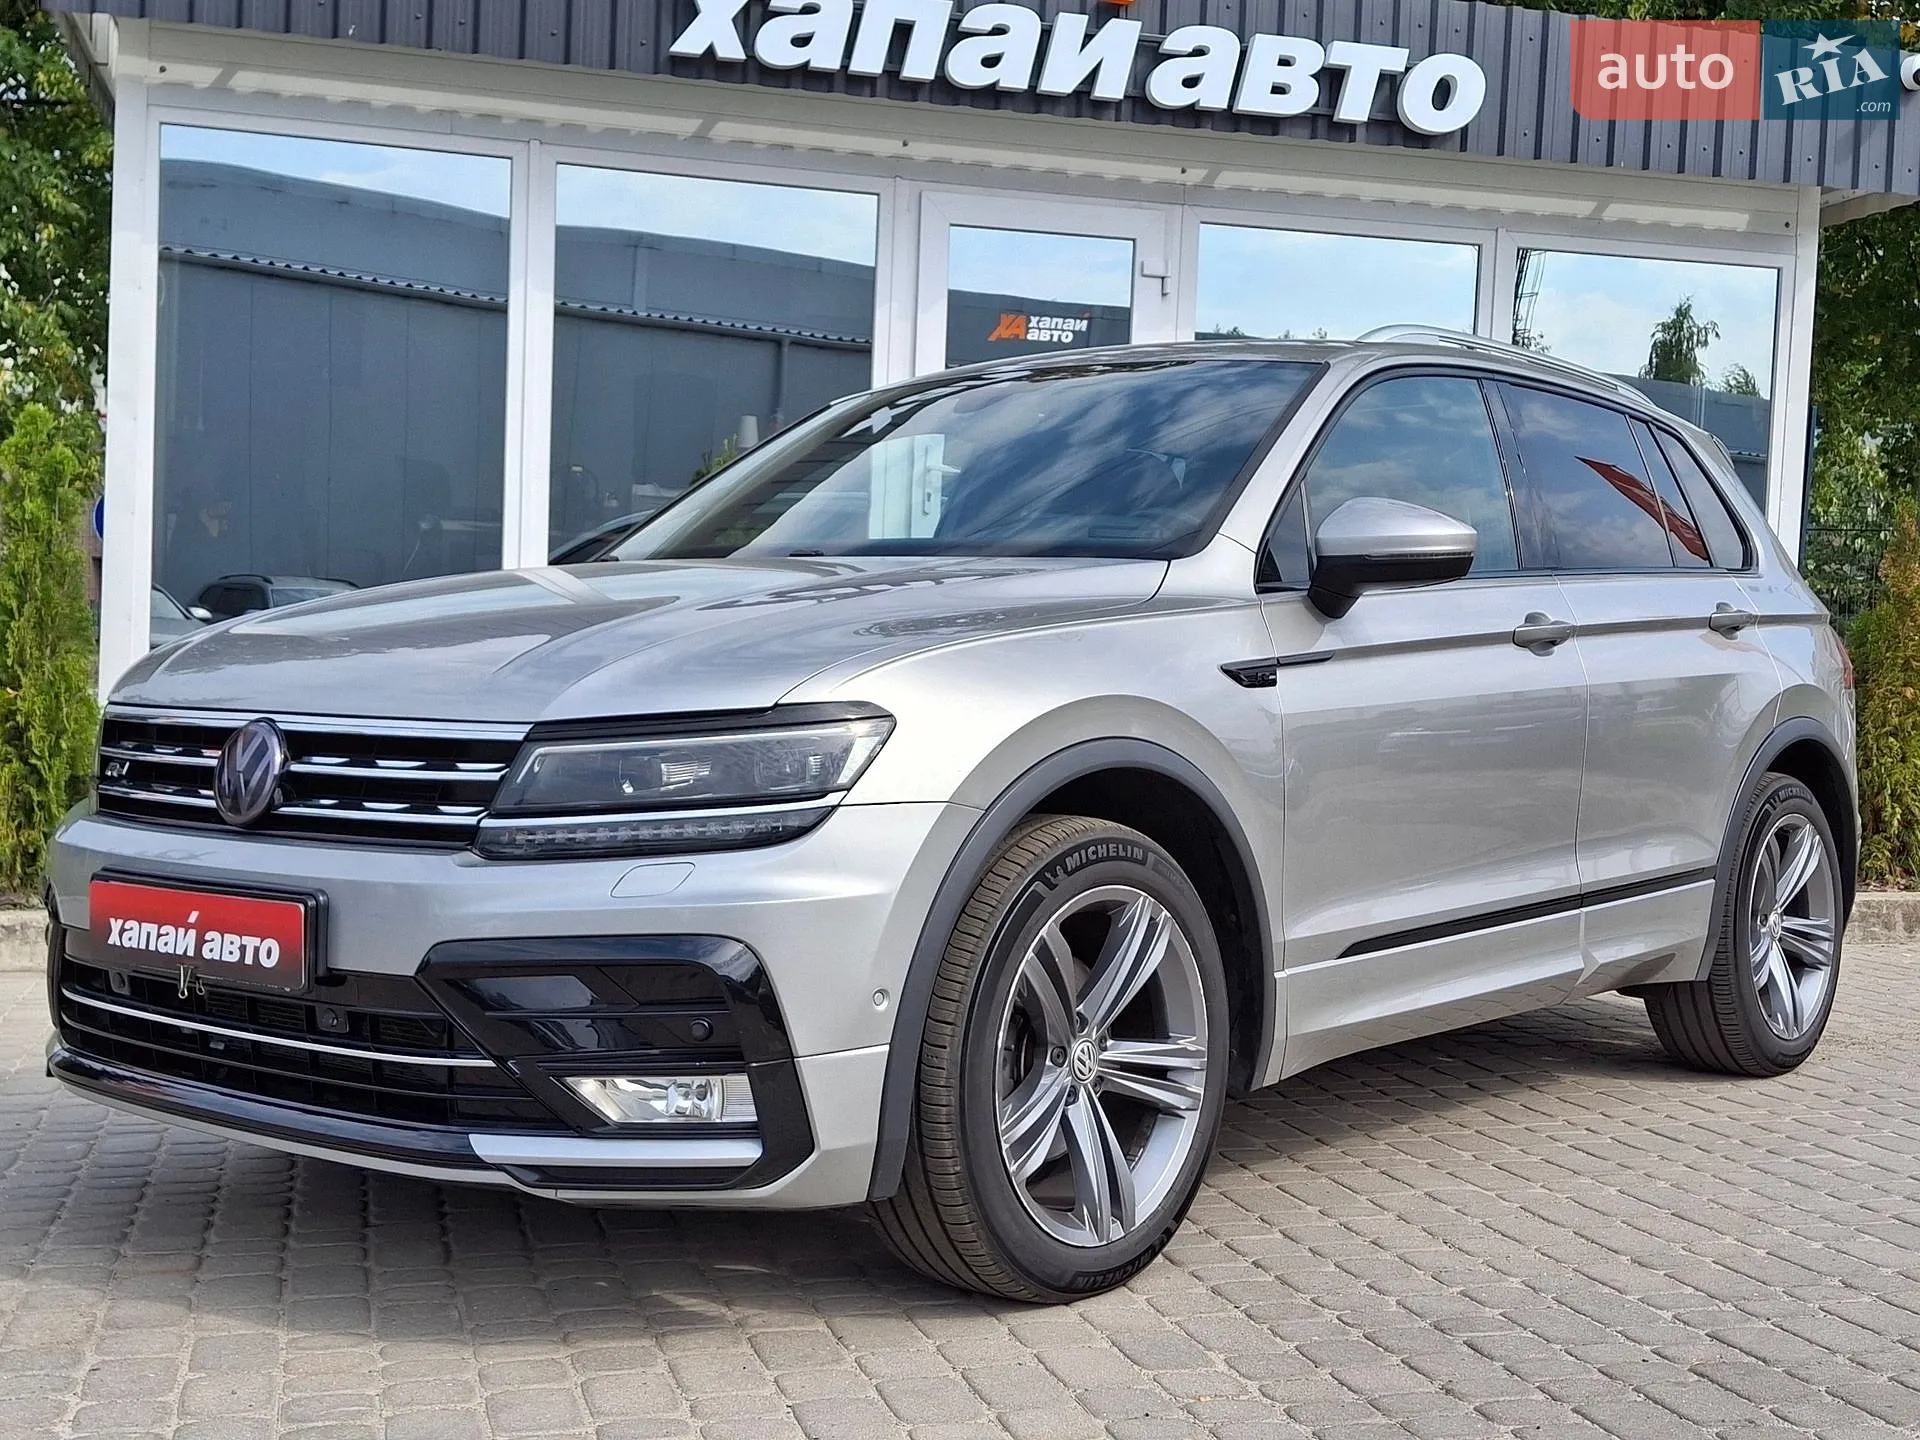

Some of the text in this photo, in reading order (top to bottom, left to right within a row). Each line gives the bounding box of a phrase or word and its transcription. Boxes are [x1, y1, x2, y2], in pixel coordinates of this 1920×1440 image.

[1145, 25, 1486, 136] авто
[1026, 329, 1074, 343] авто
[1065, 843, 1144, 872] MICHELIN
[107, 911, 280, 968] хапай авто
